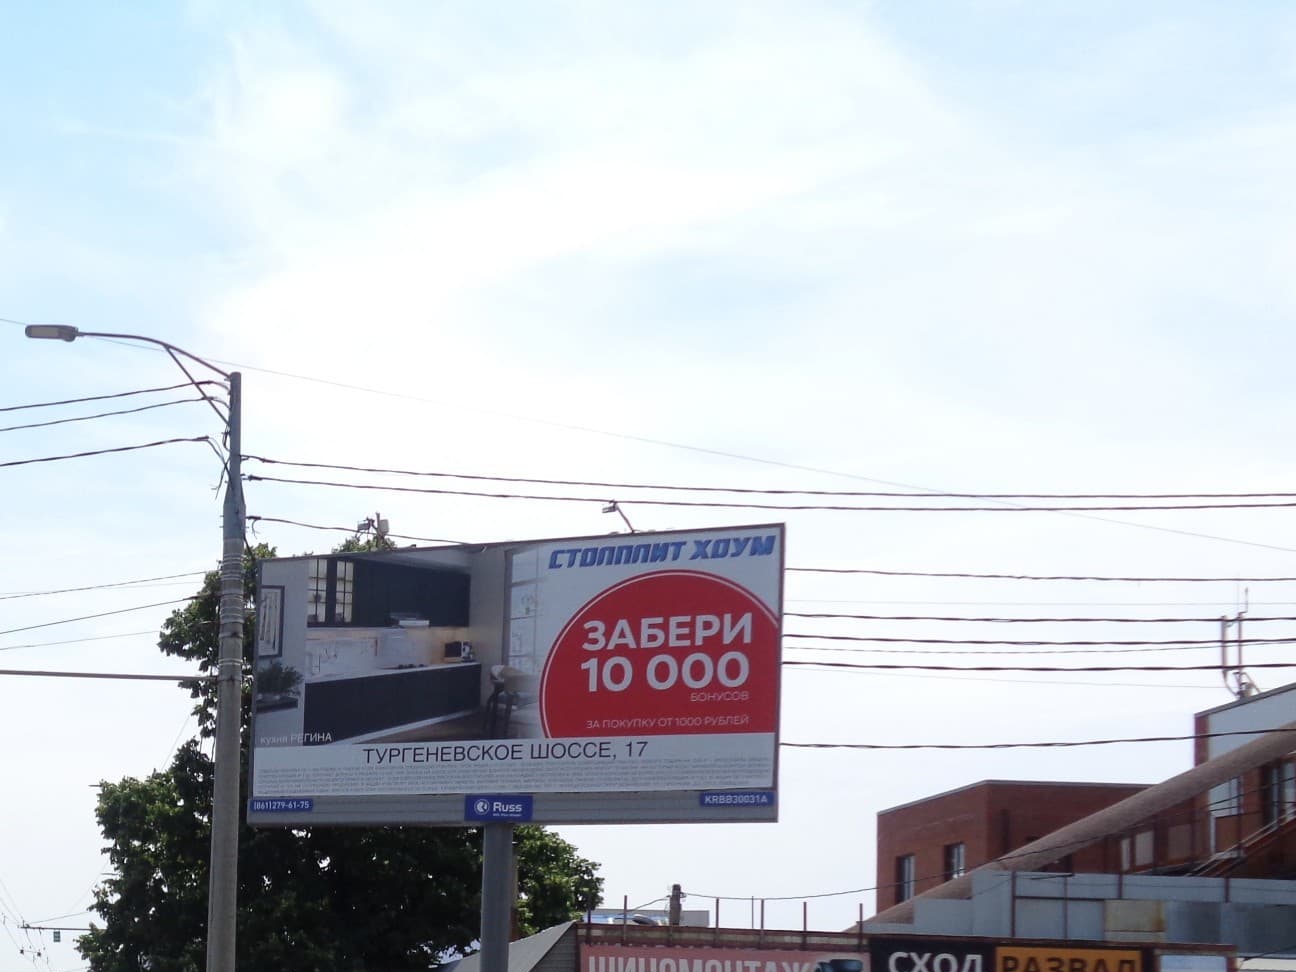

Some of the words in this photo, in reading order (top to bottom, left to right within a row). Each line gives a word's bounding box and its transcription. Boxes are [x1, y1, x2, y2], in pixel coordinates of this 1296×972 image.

[689, 535, 776, 560] ХОУМ
[582, 612, 752, 651] ЗАБЕРИ
[581, 656, 633, 693] 10
[646, 651, 750, 690] 000
[690, 691, 750, 702] БОНУСОВ
[586, 719, 600, 729] ЗА
[602, 718, 654, 729] ПОКУПКУ
[657, 717, 672, 727] ОТ
[674, 716, 702, 727] 1000
[704, 714, 750, 726] РУБЛЕЙ
[260, 736, 288, 746] кухня
[290, 732, 332, 744] РЕГИНА
[362, 745, 524, 764] ТУРГЕНЕВСКОЕ
[531, 742, 617, 760] ШОССЕ,
[625, 741, 648, 757] 17
[492, 802, 523, 813] Russ
